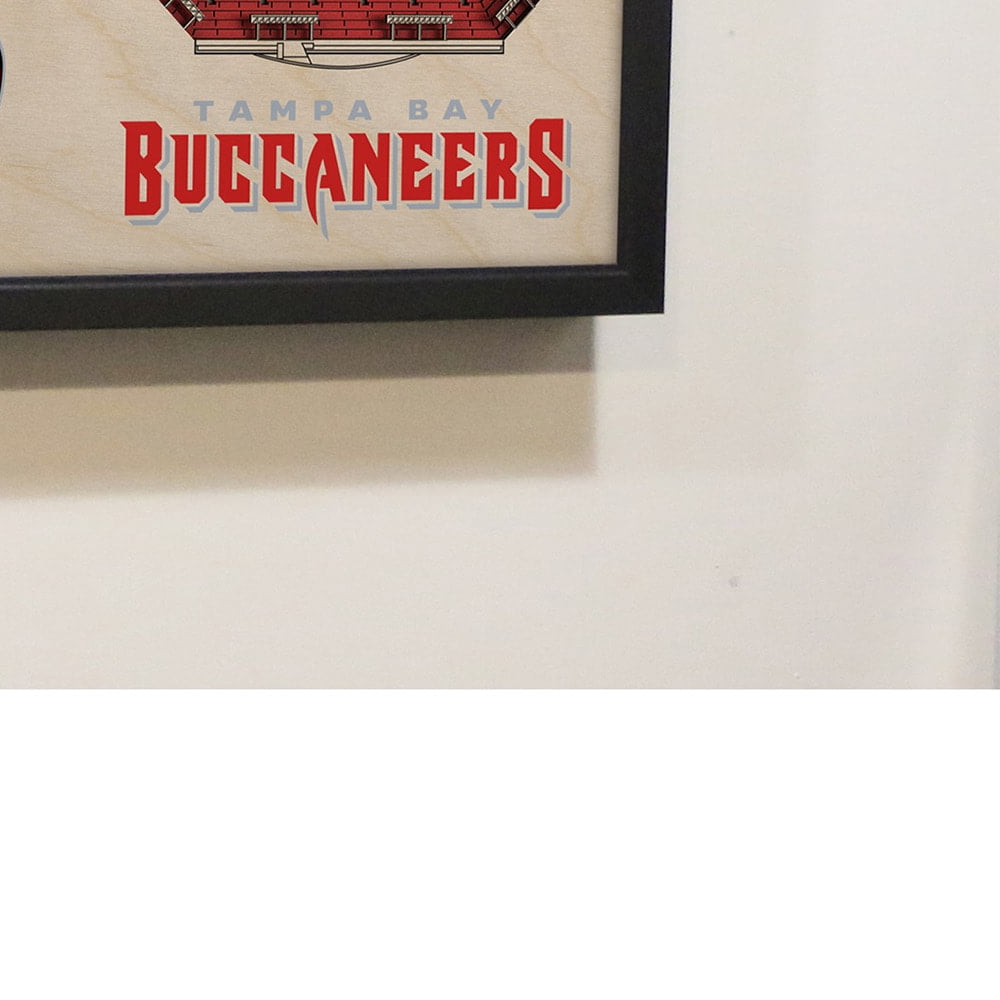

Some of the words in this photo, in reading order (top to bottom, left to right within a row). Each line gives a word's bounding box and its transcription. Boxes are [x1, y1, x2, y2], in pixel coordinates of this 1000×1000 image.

[194, 100, 372, 121] TAMPA
[409, 99, 502, 120] BAY
[120, 118, 569, 232] BUCCANEERS
